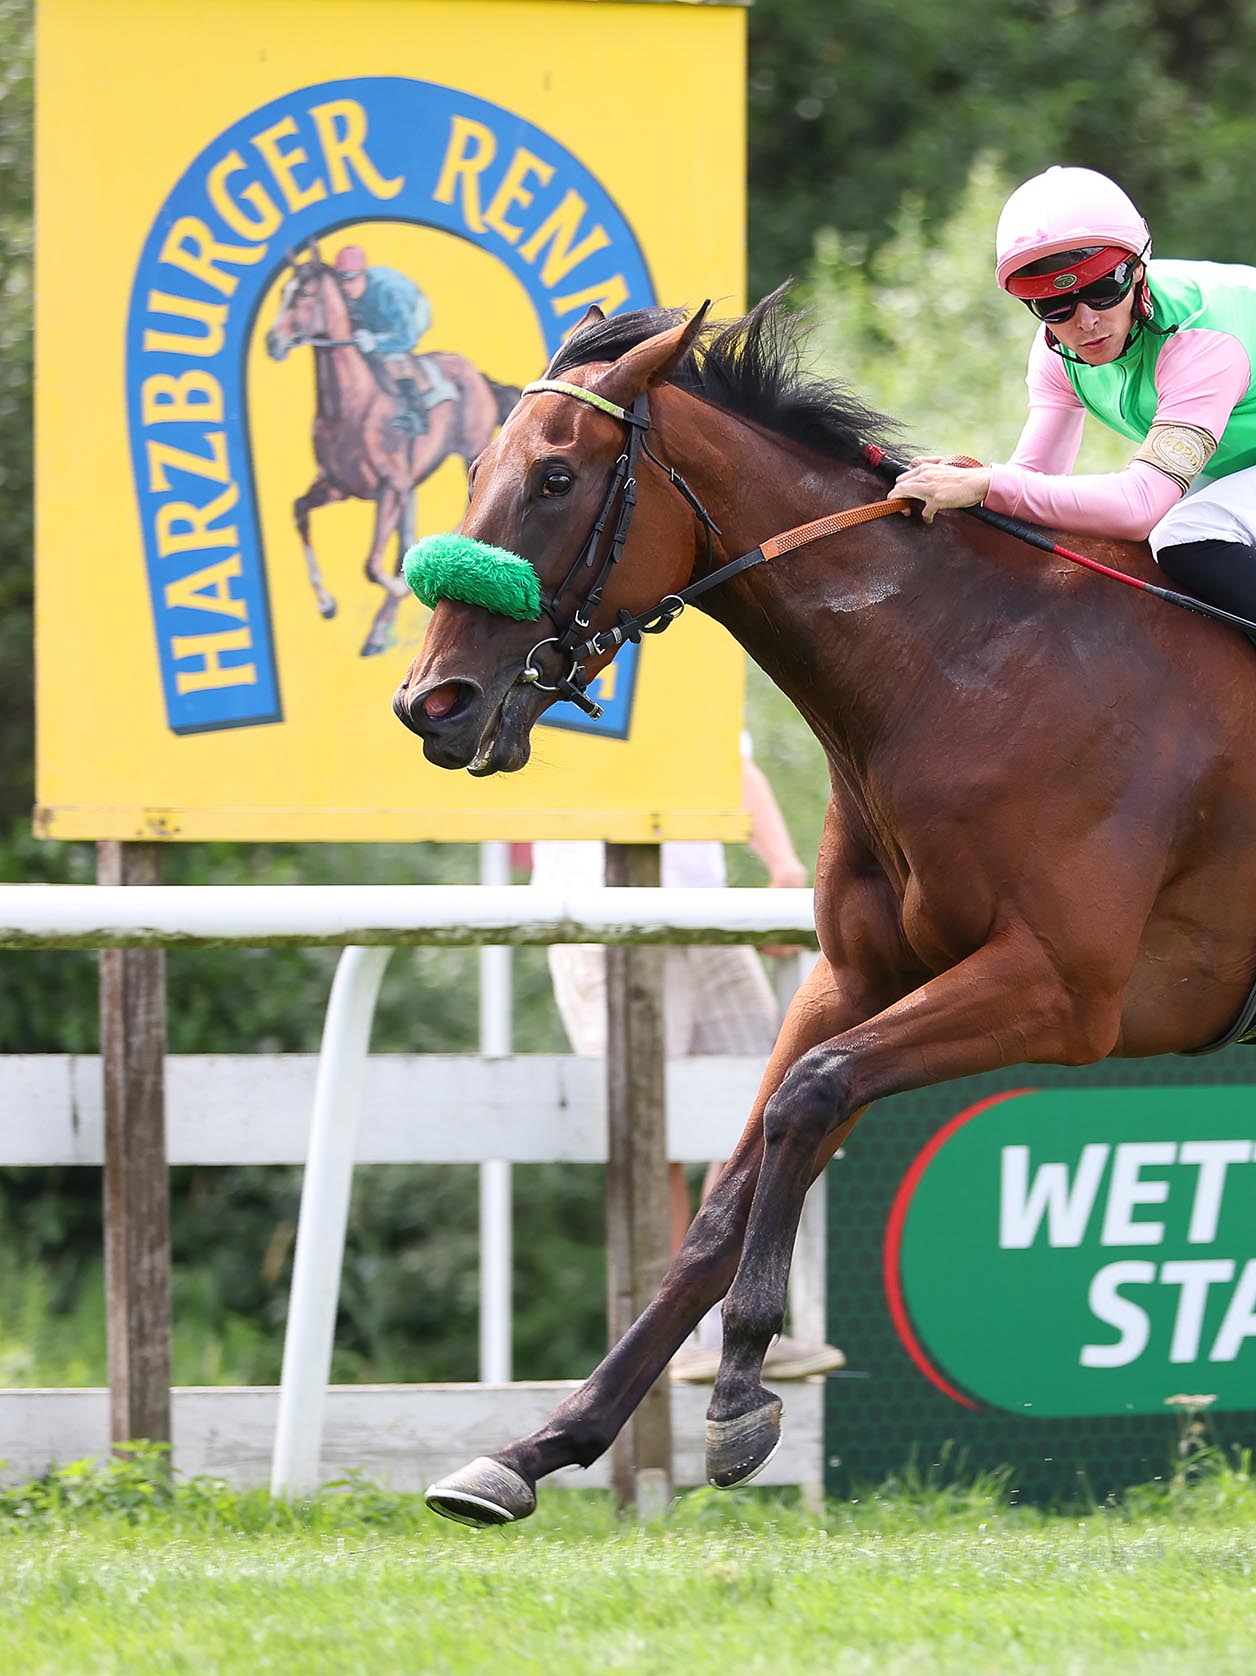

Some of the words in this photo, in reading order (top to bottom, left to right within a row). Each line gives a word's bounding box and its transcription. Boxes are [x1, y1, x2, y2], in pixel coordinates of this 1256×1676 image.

[142, 98, 405, 694] HARZBURGER
[431, 115, 630, 342] RENN
[1162, 434, 1201, 467] 2025
